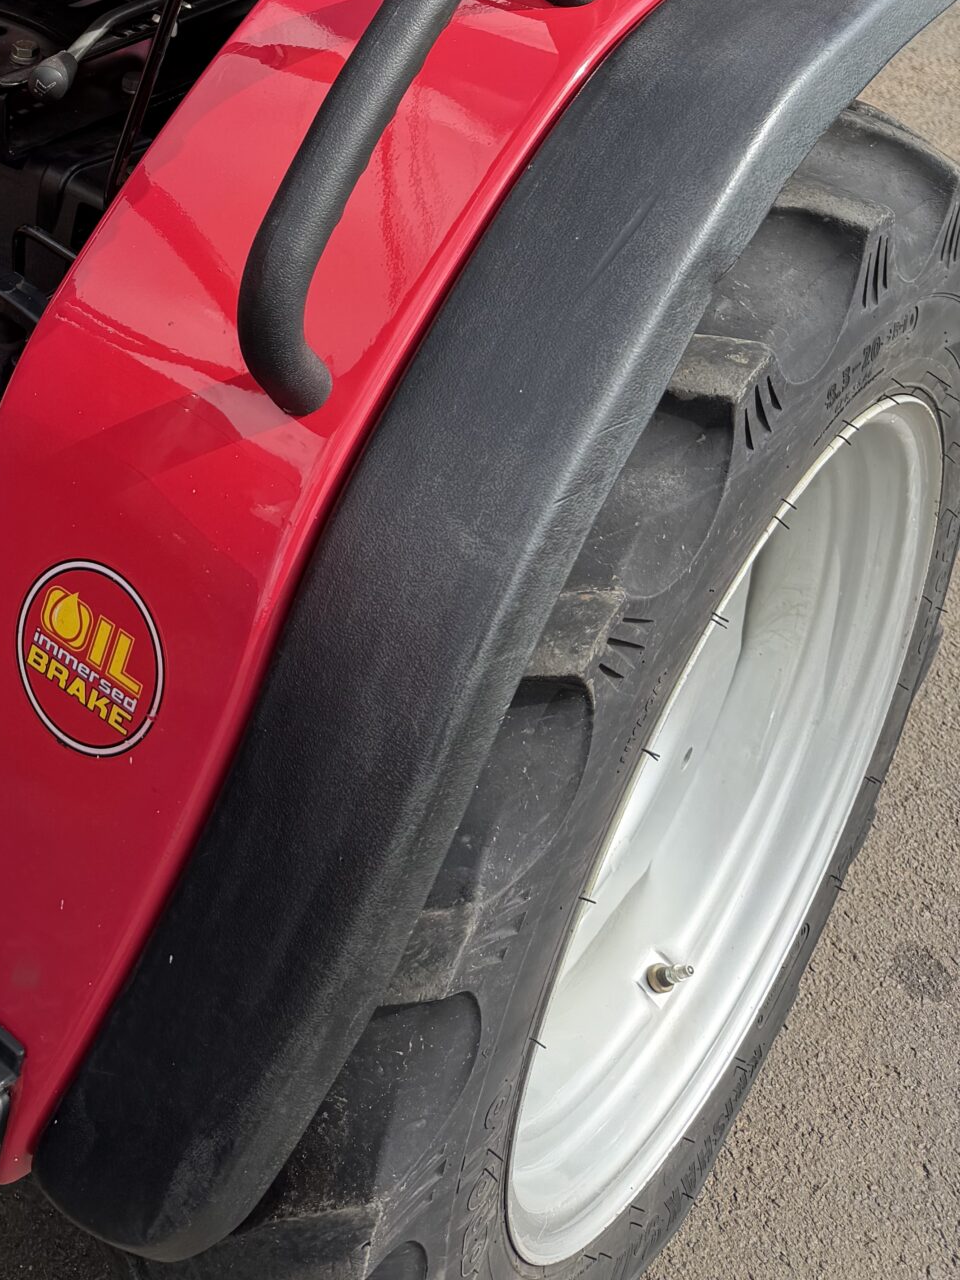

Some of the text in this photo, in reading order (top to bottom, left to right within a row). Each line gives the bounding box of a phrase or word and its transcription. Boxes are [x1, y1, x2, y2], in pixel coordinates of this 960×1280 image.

[33, 627, 138, 713] immersed
[41, 585, 143, 698] OIL
[26, 644, 132, 736] BRAKE
